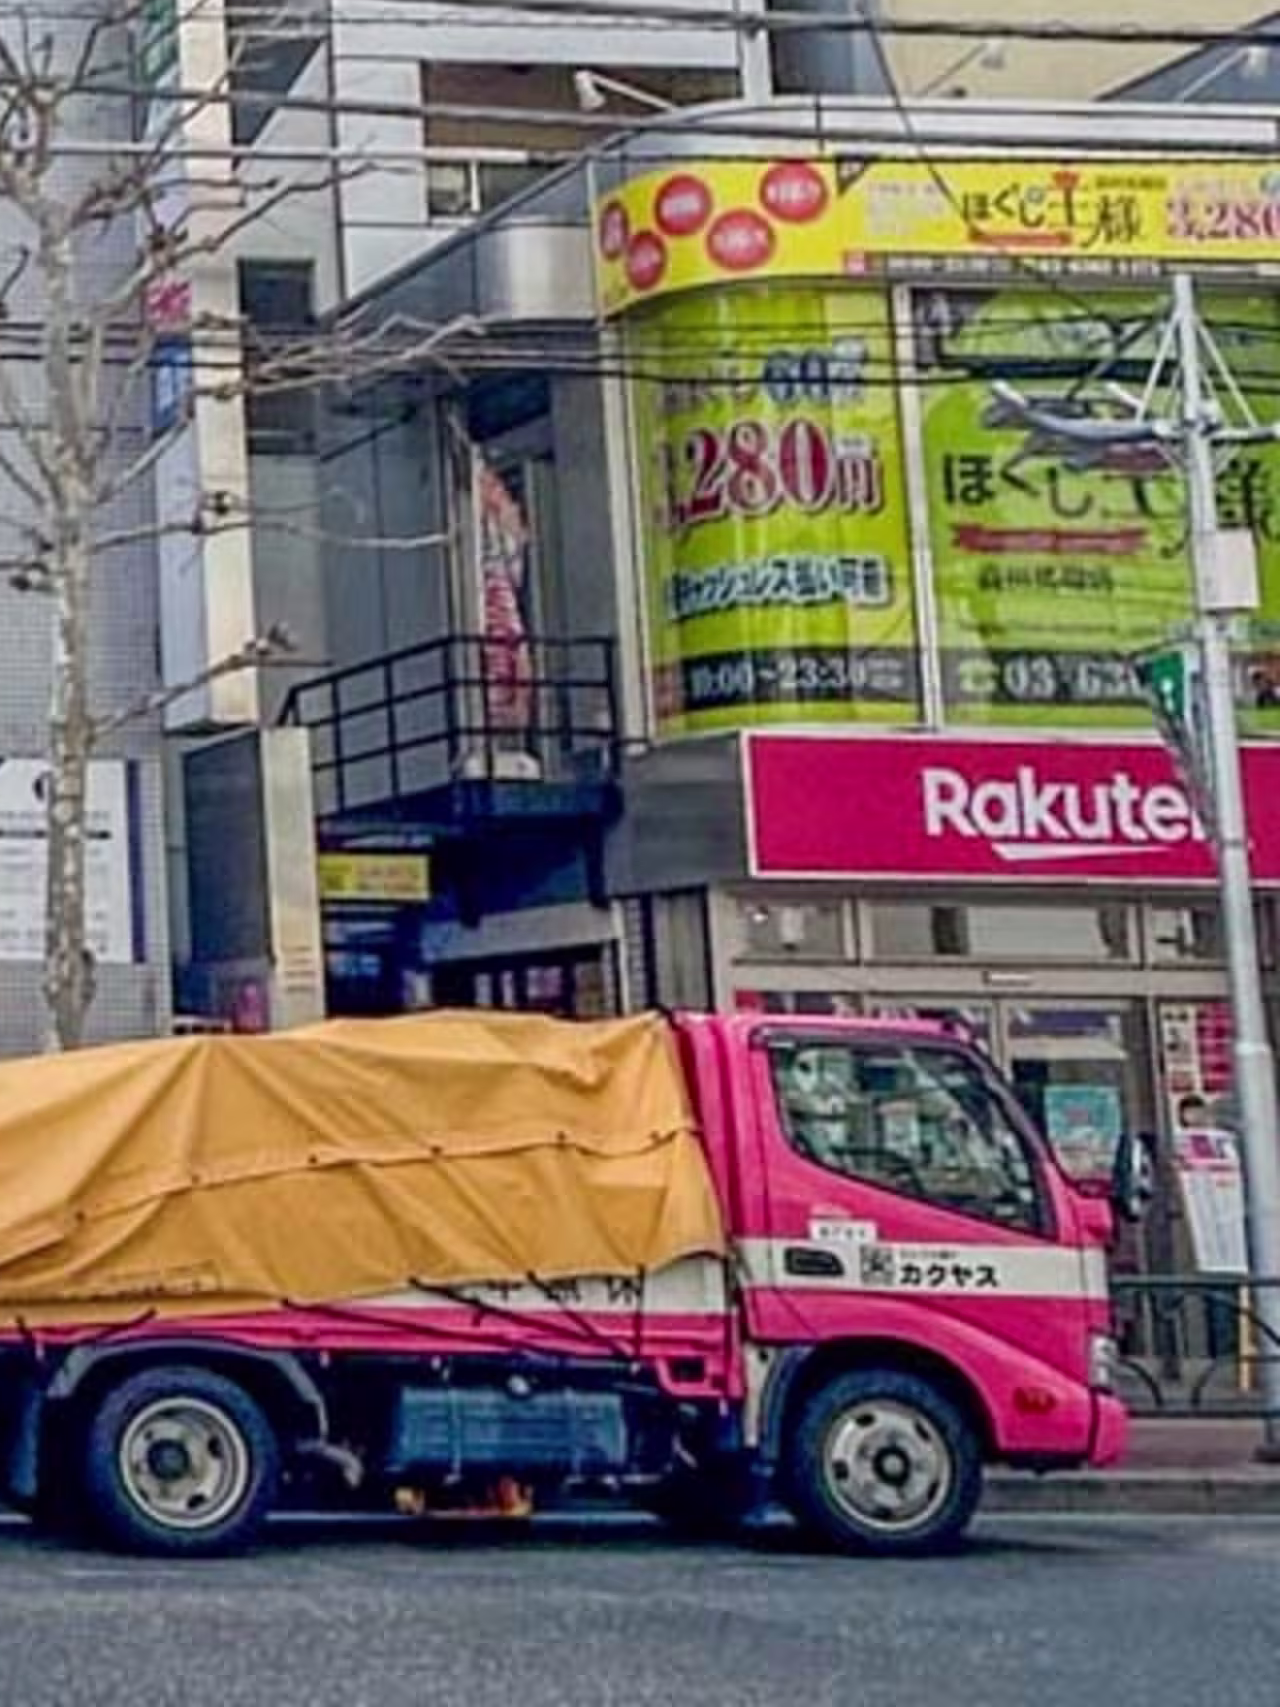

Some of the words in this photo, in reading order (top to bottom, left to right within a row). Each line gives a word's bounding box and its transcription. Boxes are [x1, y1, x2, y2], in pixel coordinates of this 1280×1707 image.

[922, 767, 1206, 841] Rakute
[900, 1263, 998, 1288] カクヤス
